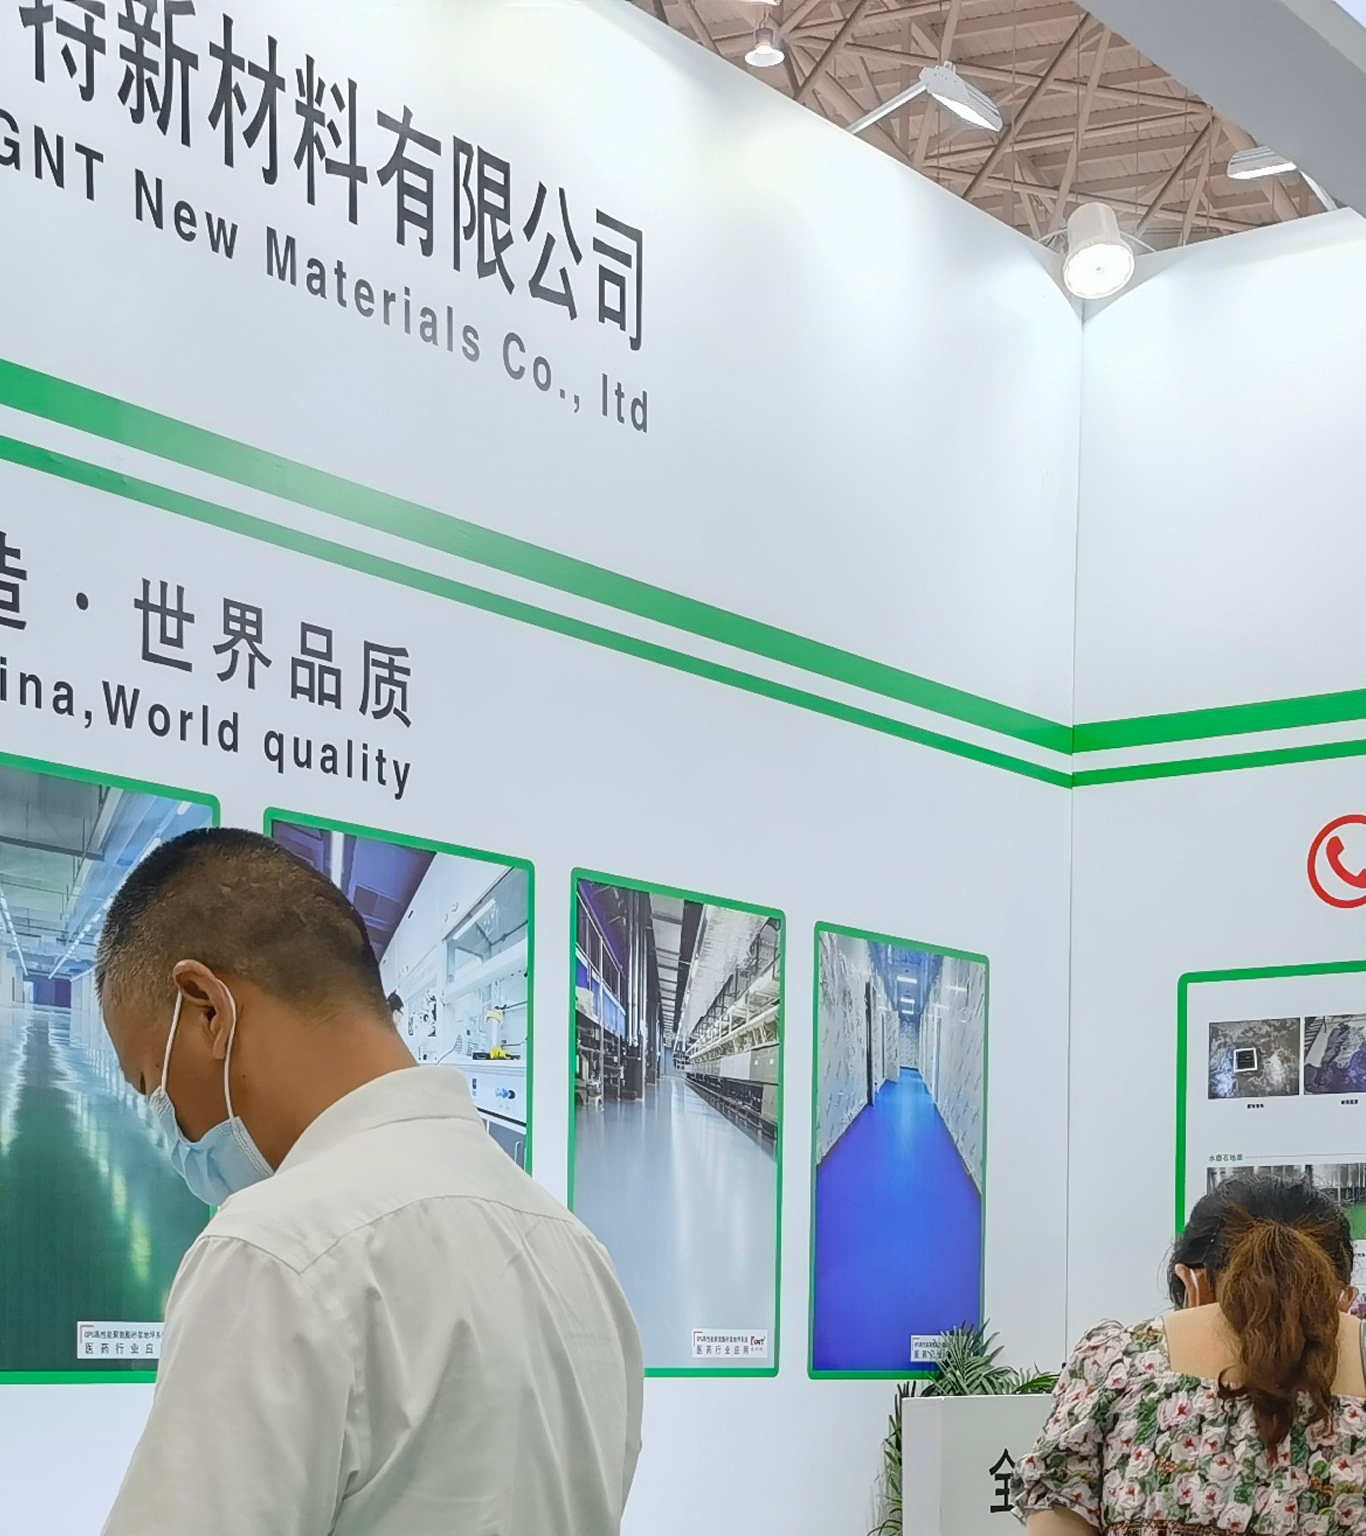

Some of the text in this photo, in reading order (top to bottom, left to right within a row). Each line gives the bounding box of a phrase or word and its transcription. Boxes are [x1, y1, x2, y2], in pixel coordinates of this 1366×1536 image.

[135, 167, 237, 261] New
[266, 228, 481, 364] Materials
[502, 335, 581, 413] Co.,
[601, 372, 649, 434] ltd
[264, 722, 412, 800] quality
